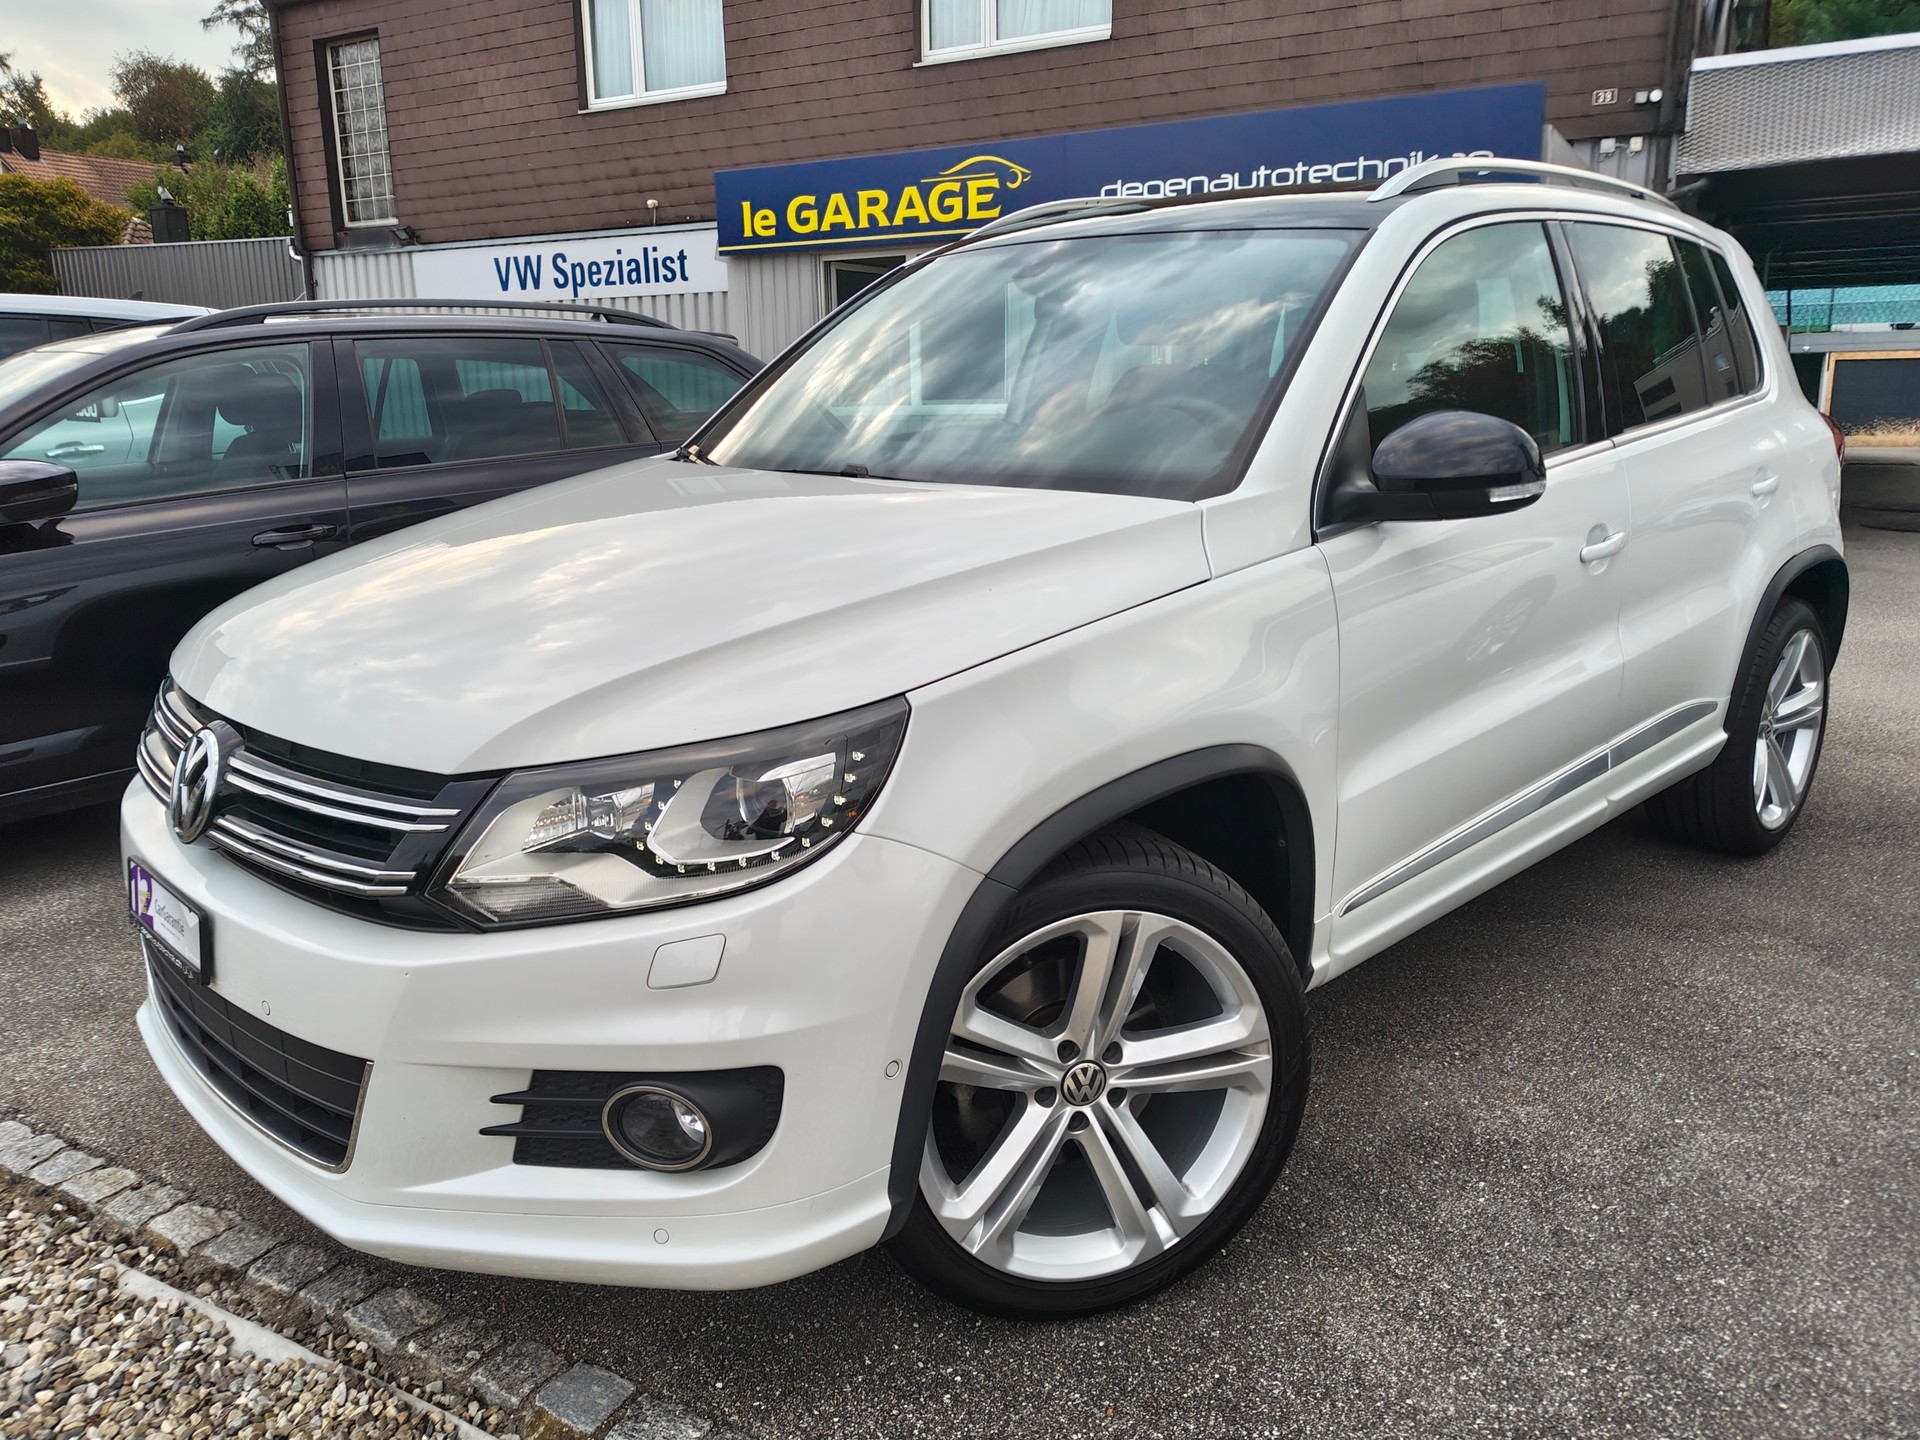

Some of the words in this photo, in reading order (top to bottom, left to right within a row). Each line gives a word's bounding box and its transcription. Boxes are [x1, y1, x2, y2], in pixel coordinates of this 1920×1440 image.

[741, 201, 777, 237] le
[786, 178, 1002, 234] GARAGE
[494, 254, 542, 292] VW
[551, 246, 689, 298] Spezialist
[1063, 1063, 1105, 1104] VW
